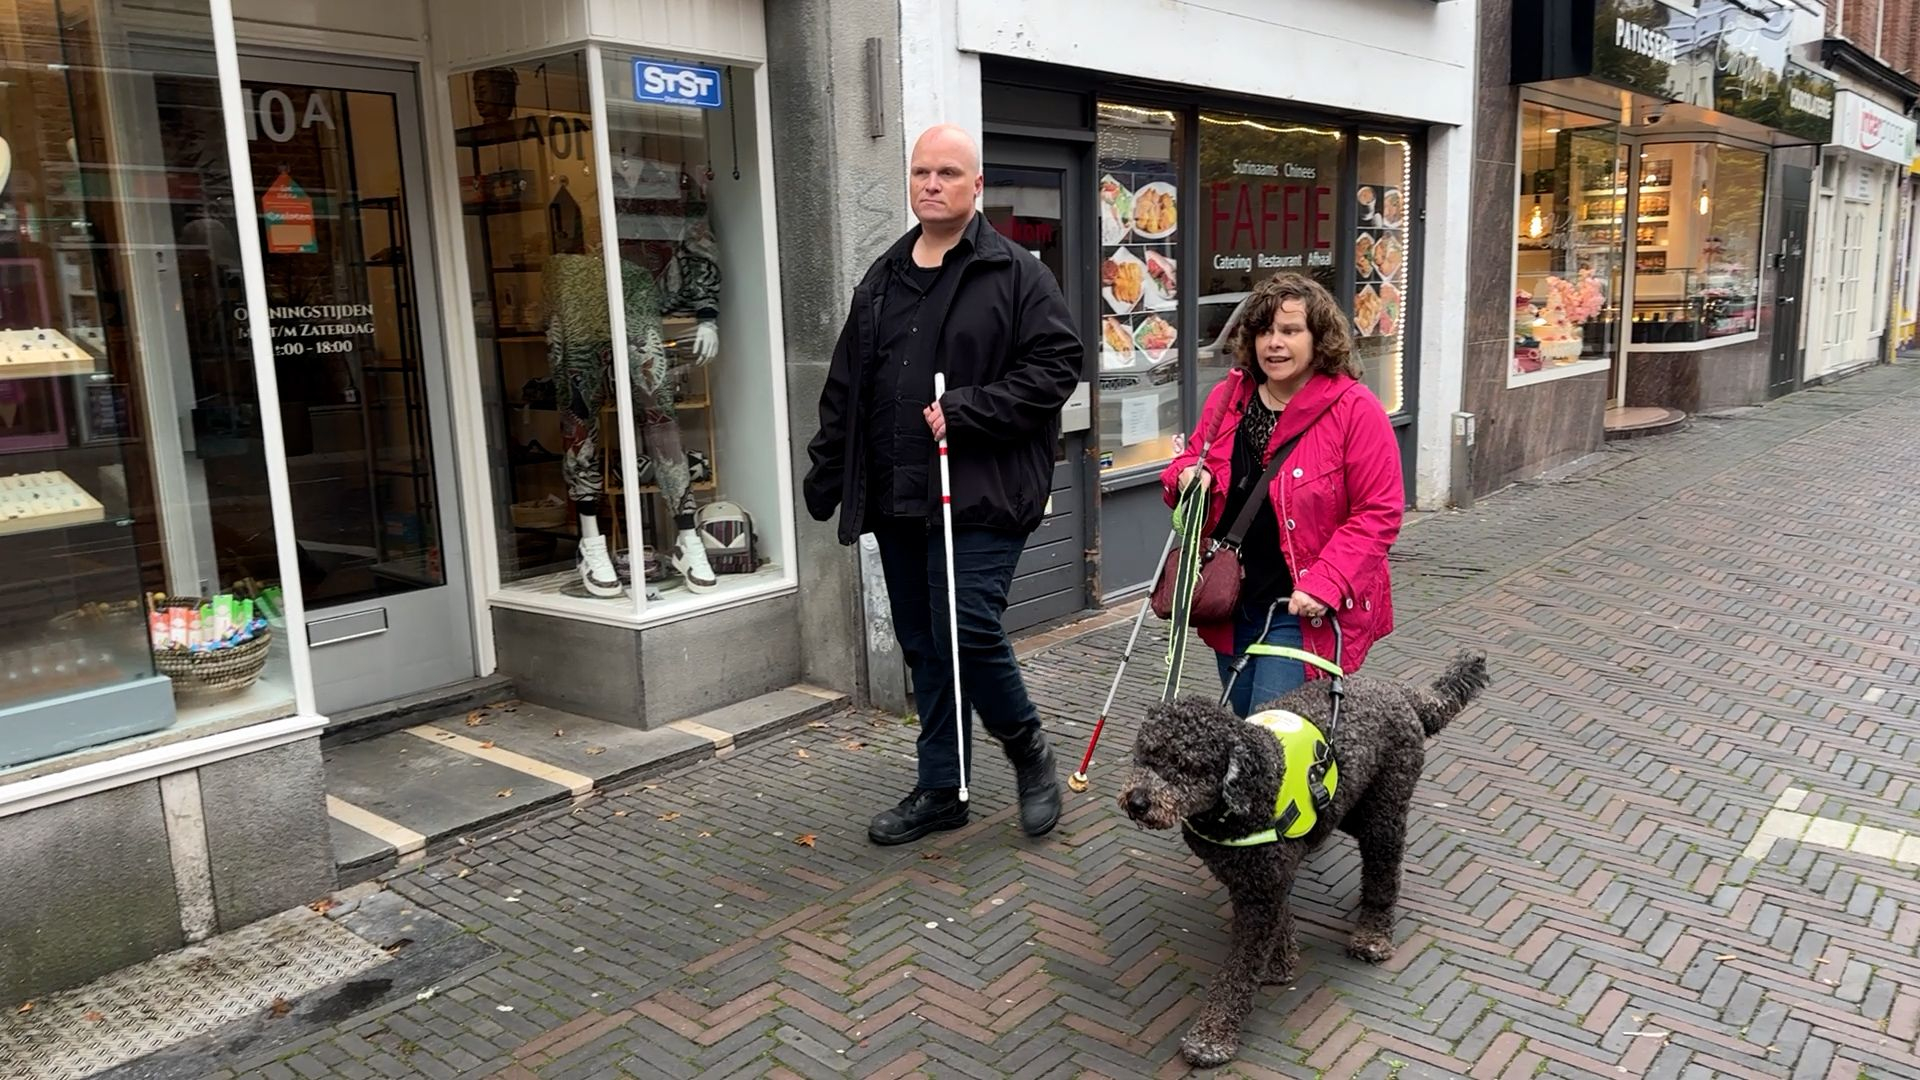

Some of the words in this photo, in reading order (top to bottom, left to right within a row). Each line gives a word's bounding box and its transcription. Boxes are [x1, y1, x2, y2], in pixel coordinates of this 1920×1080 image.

[1232, 159, 1279, 176] Surinaams
[1283, 162, 1317, 179] Chinees
[1211, 182, 1332, 251] FAFFIE
[1213, 253, 1252, 272] Catering
[1257, 252, 1303, 268] Restaurant
[233, 303, 375, 321] ONINGSTIJDEN
[315, 340, 353, 355] 18:00
